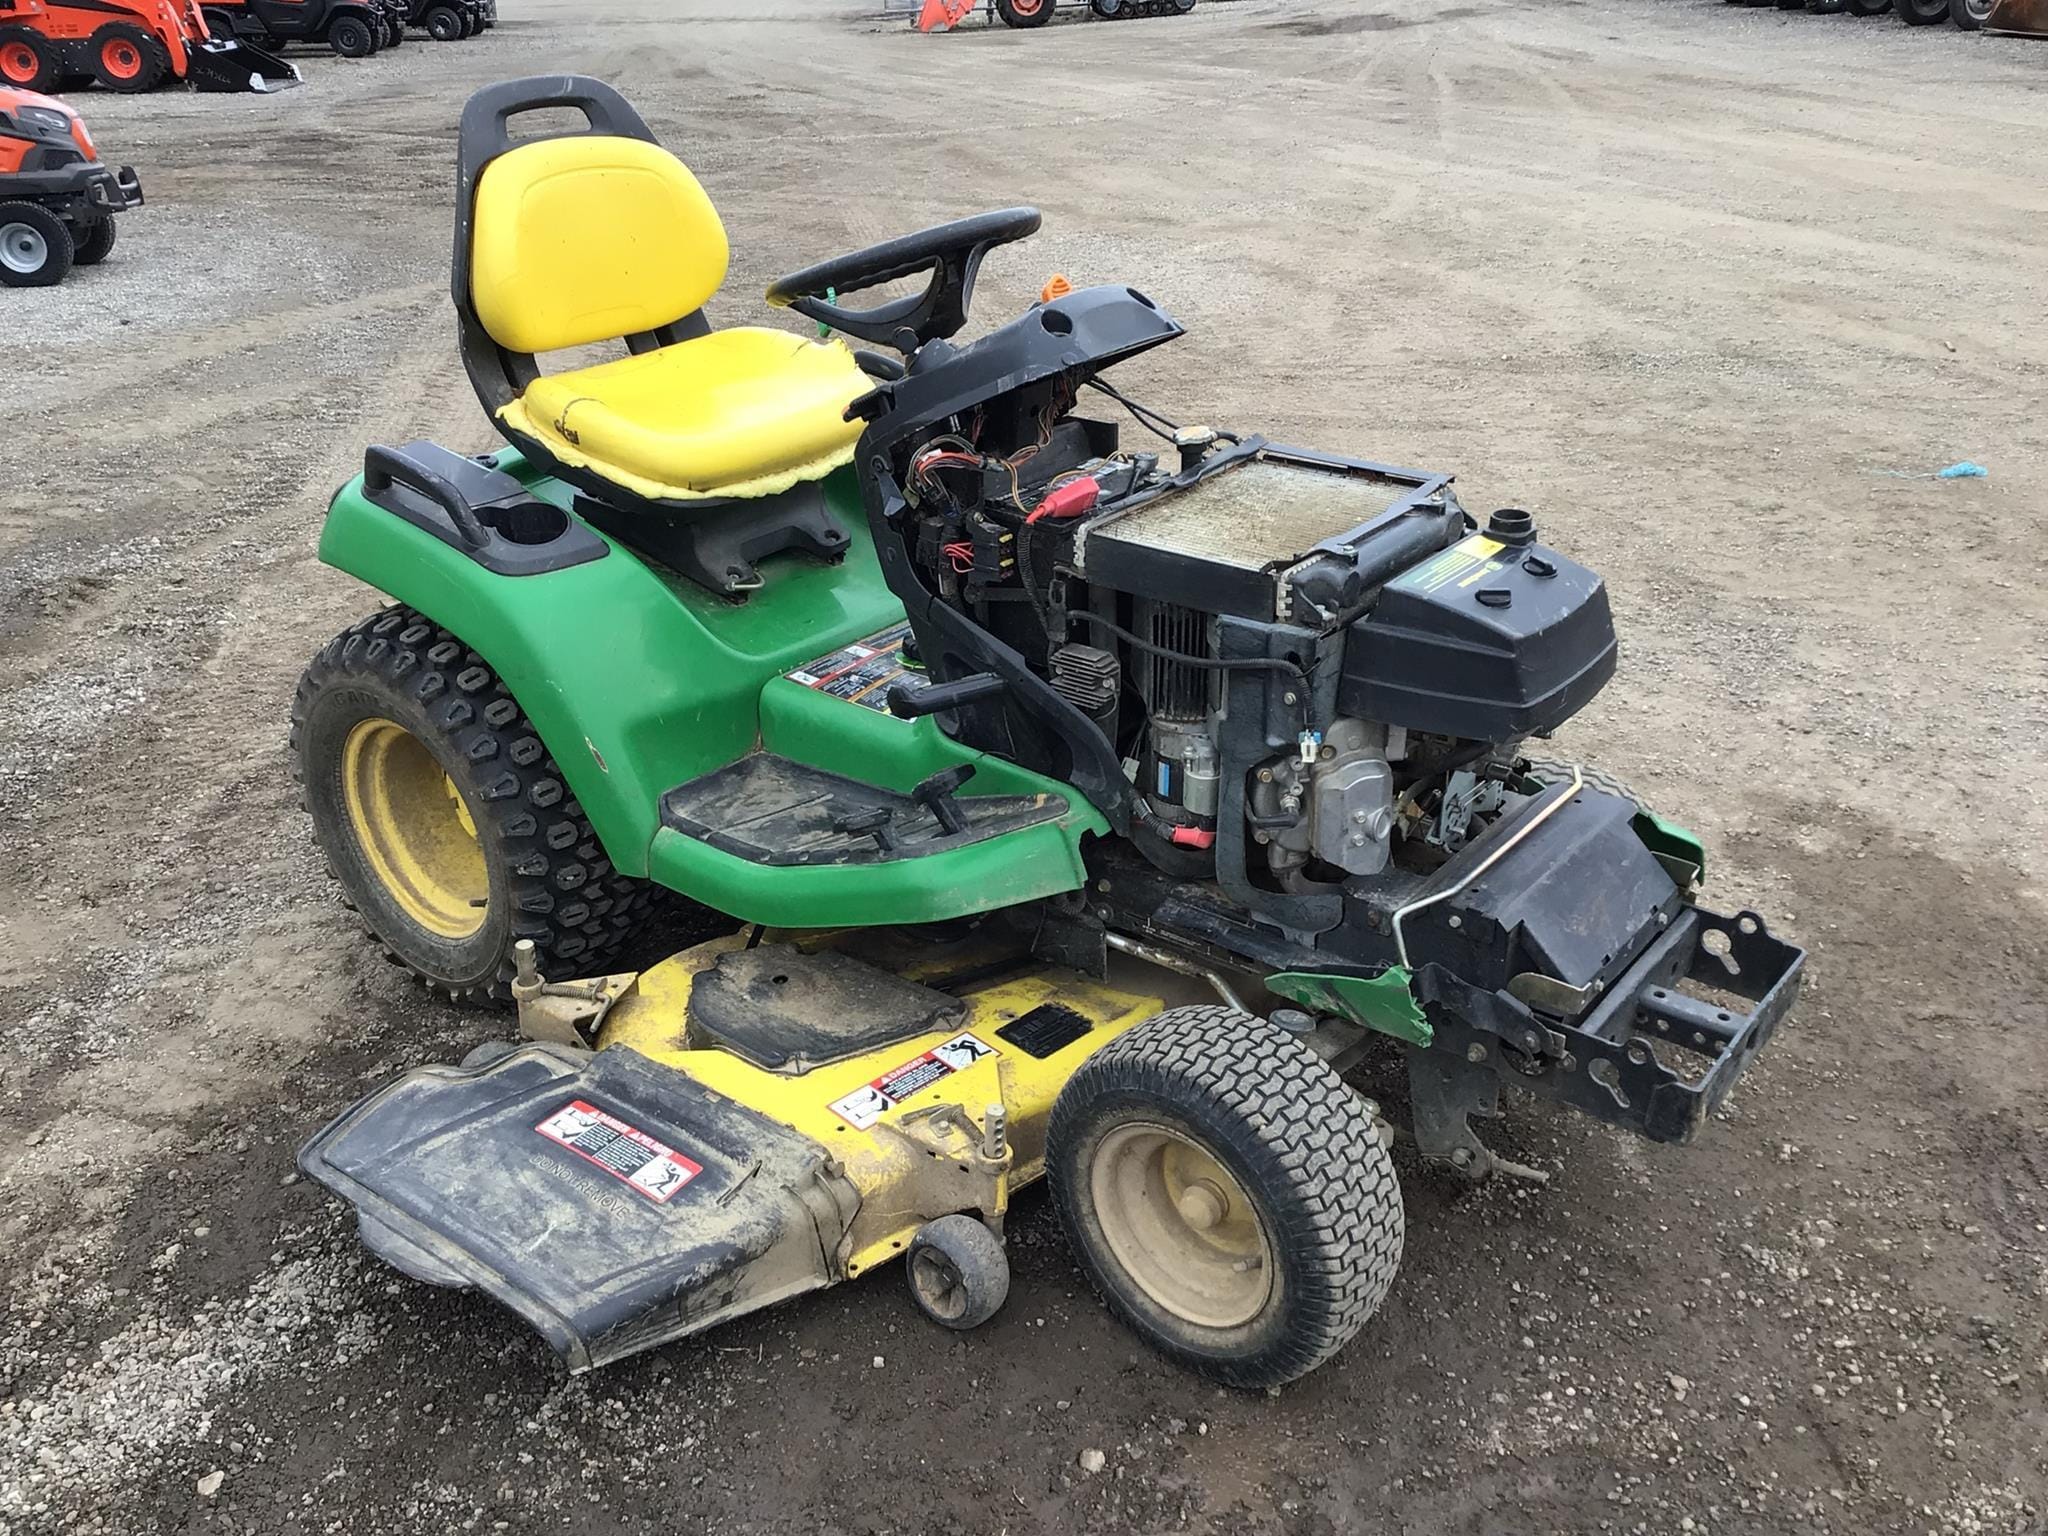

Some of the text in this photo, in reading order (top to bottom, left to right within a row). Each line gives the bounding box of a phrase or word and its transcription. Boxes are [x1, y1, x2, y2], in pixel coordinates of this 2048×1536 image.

[888, 1056, 927, 1079] DANGER
[529, 1153, 554, 1171] DO
[575, 1178, 630, 1220] REMOVE
